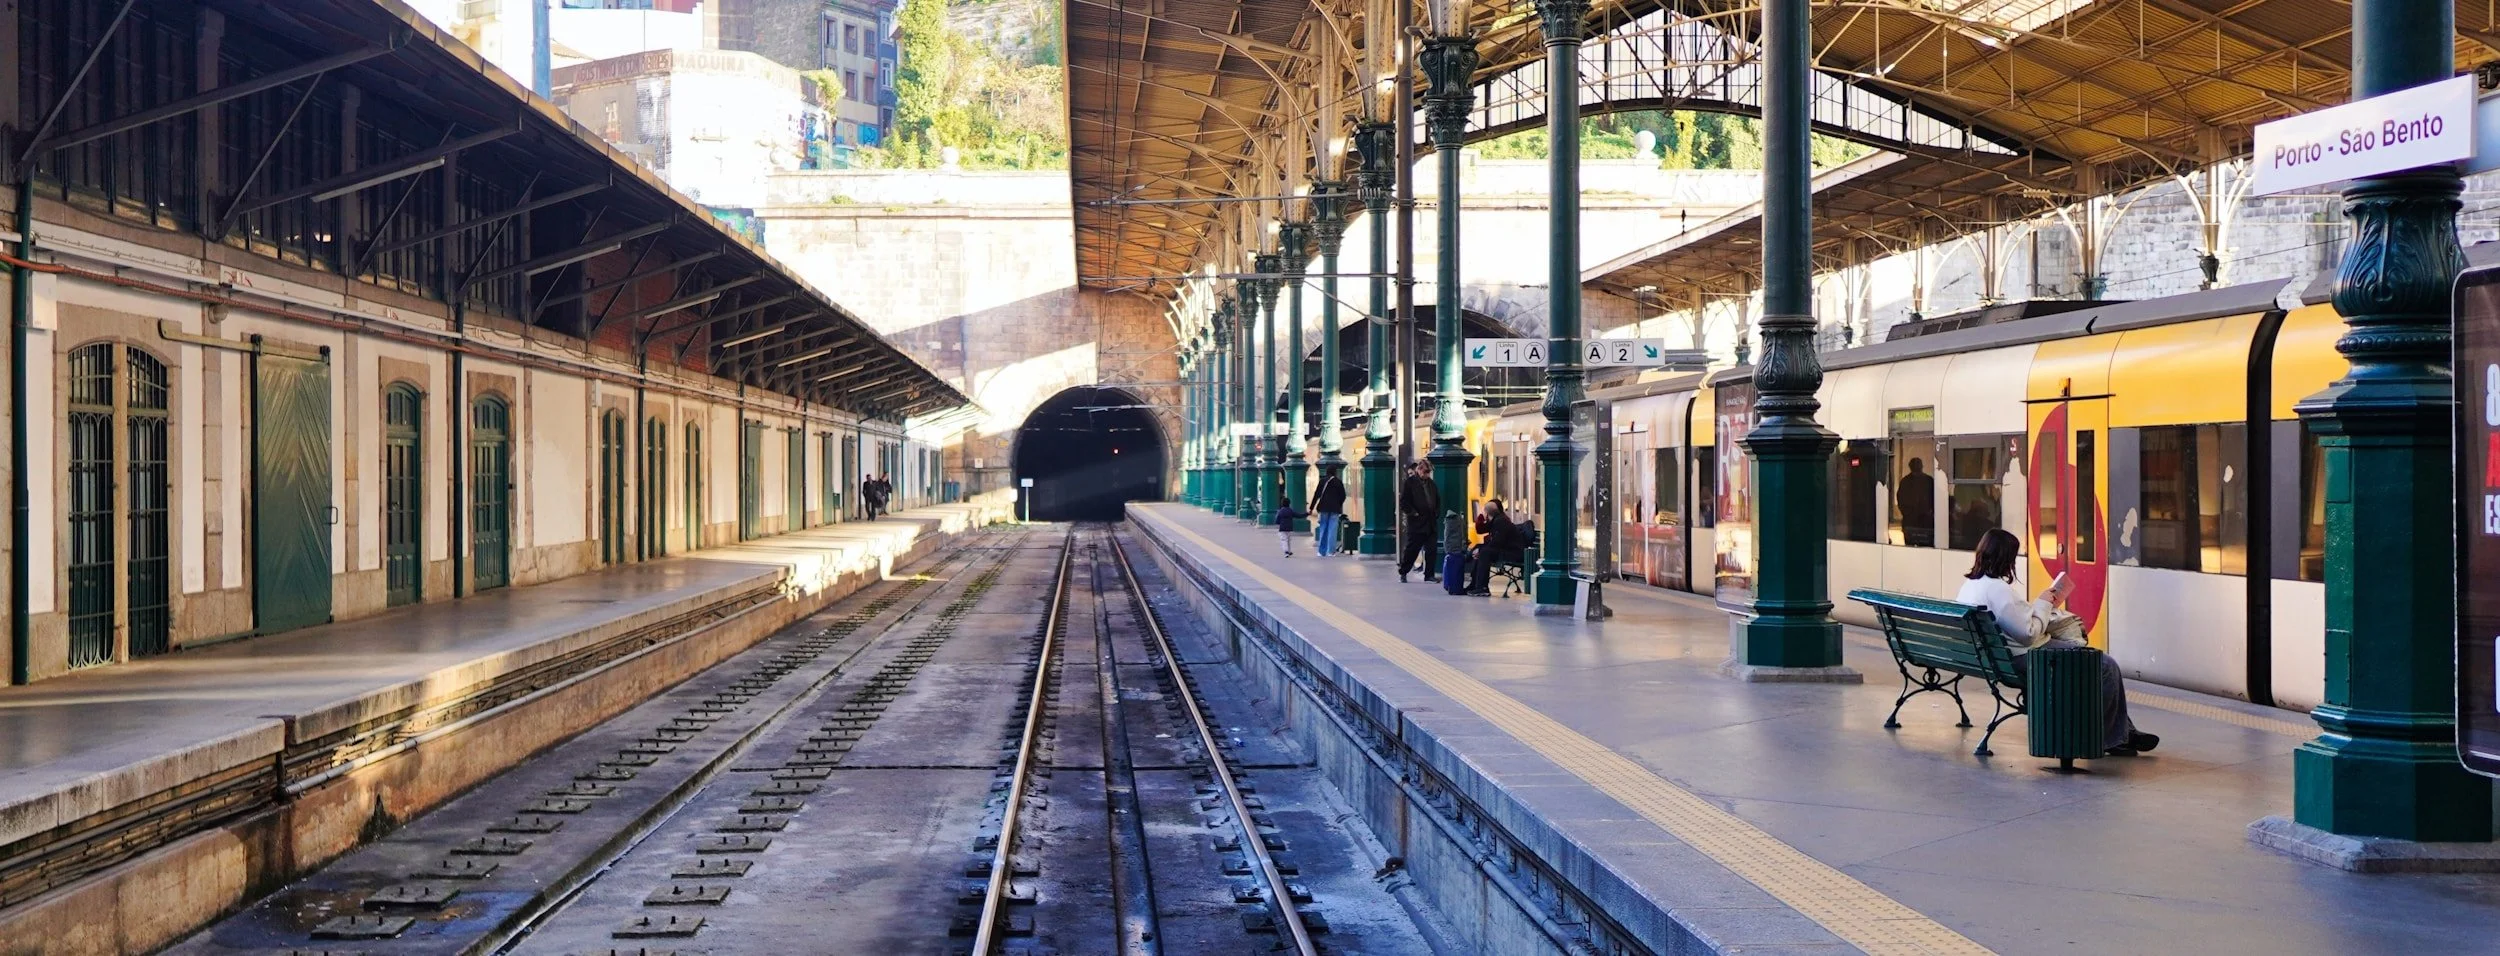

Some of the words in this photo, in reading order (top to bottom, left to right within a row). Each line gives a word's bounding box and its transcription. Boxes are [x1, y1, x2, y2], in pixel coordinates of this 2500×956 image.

[2275, 139, 2321, 169] Porto
[2339, 127, 2375, 156] São
[2383, 112, 2443, 147] Bento
[1504, 348, 1510, 361] 1
[1528, 347, 1541, 360] A
[1589, 347, 1601, 360] A
[1619, 348, 1628, 361] 2
